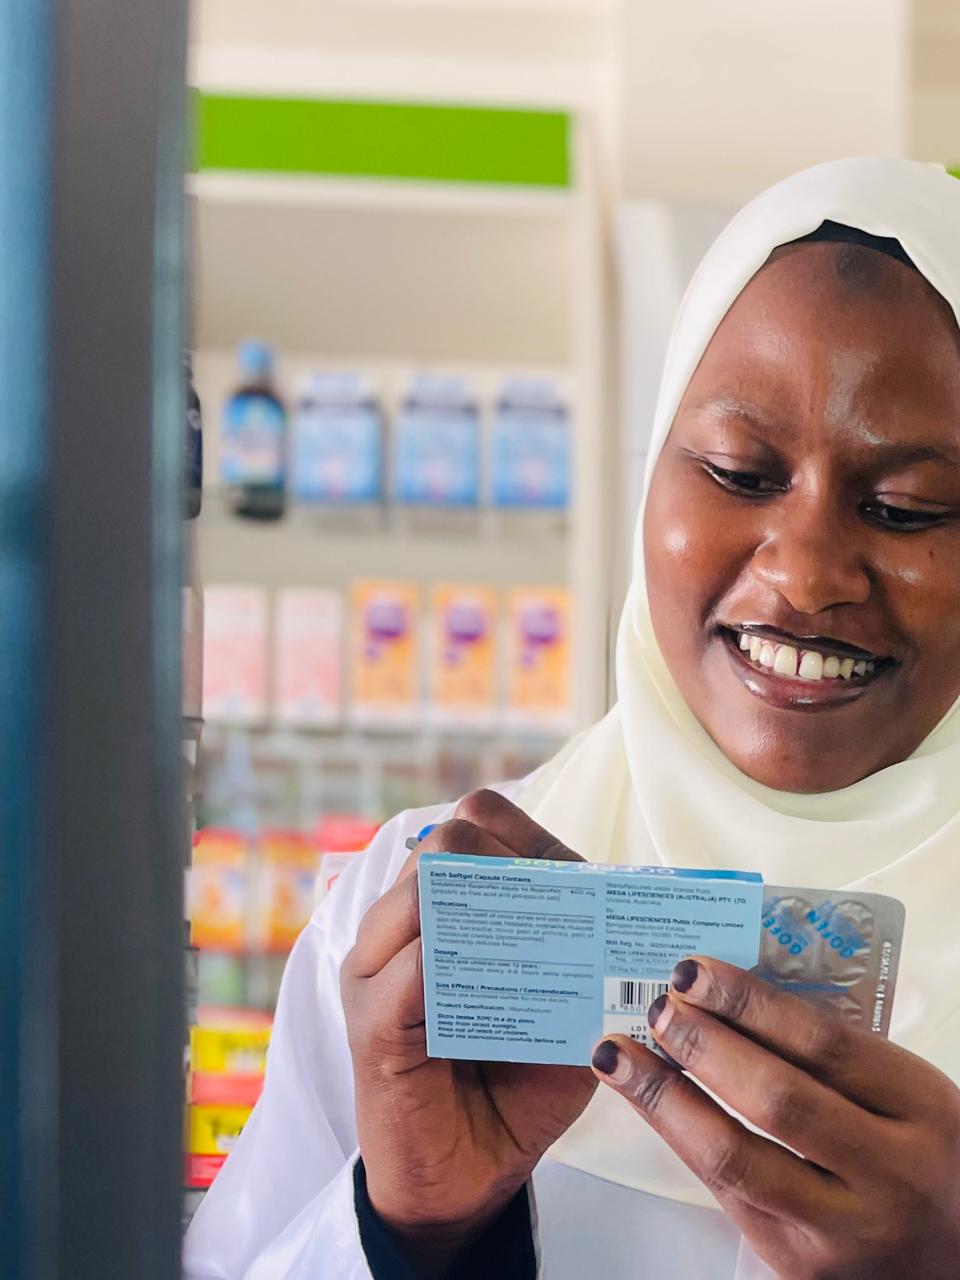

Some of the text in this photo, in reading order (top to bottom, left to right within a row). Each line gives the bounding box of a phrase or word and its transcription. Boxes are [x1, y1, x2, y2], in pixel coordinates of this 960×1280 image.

[676, 894, 717, 903] (AUSTRALIA)
[627, 916, 671, 924] LIFESCIENCES
[692, 920, 720, 928] Company
